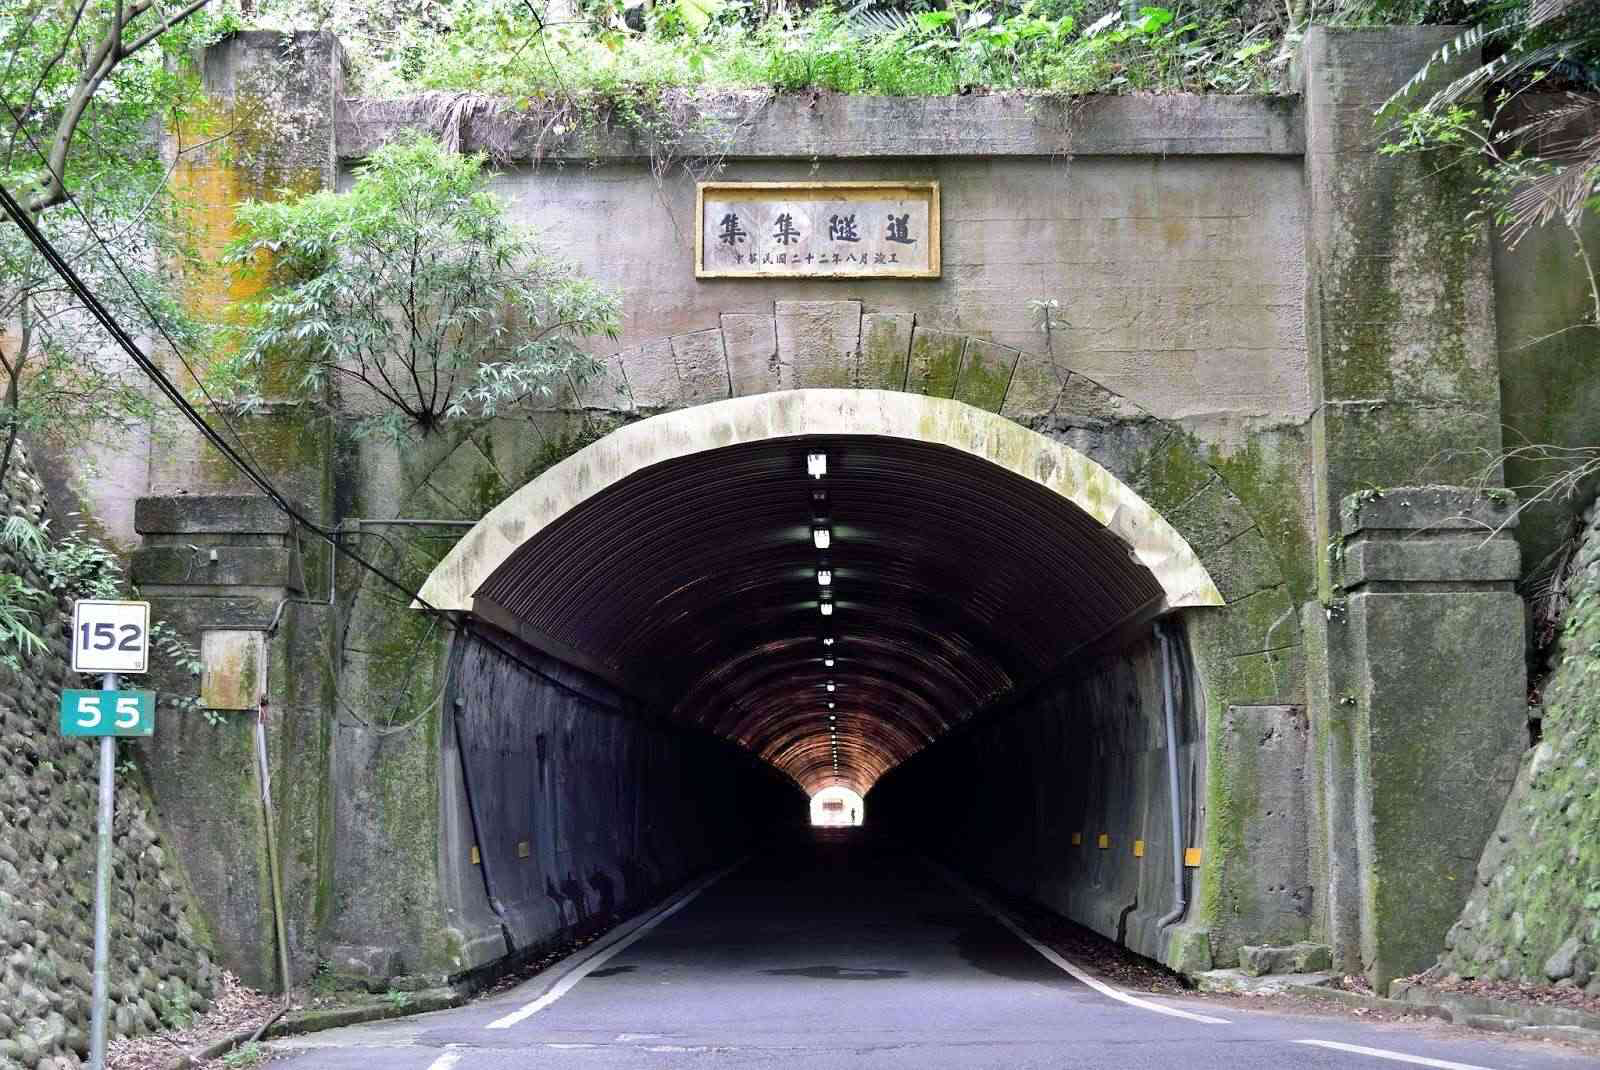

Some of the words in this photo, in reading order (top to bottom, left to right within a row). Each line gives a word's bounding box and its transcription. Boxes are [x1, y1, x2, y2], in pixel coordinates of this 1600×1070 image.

[718, 213, 917, 246] 集集隧道
[80, 622, 142, 651] 152
